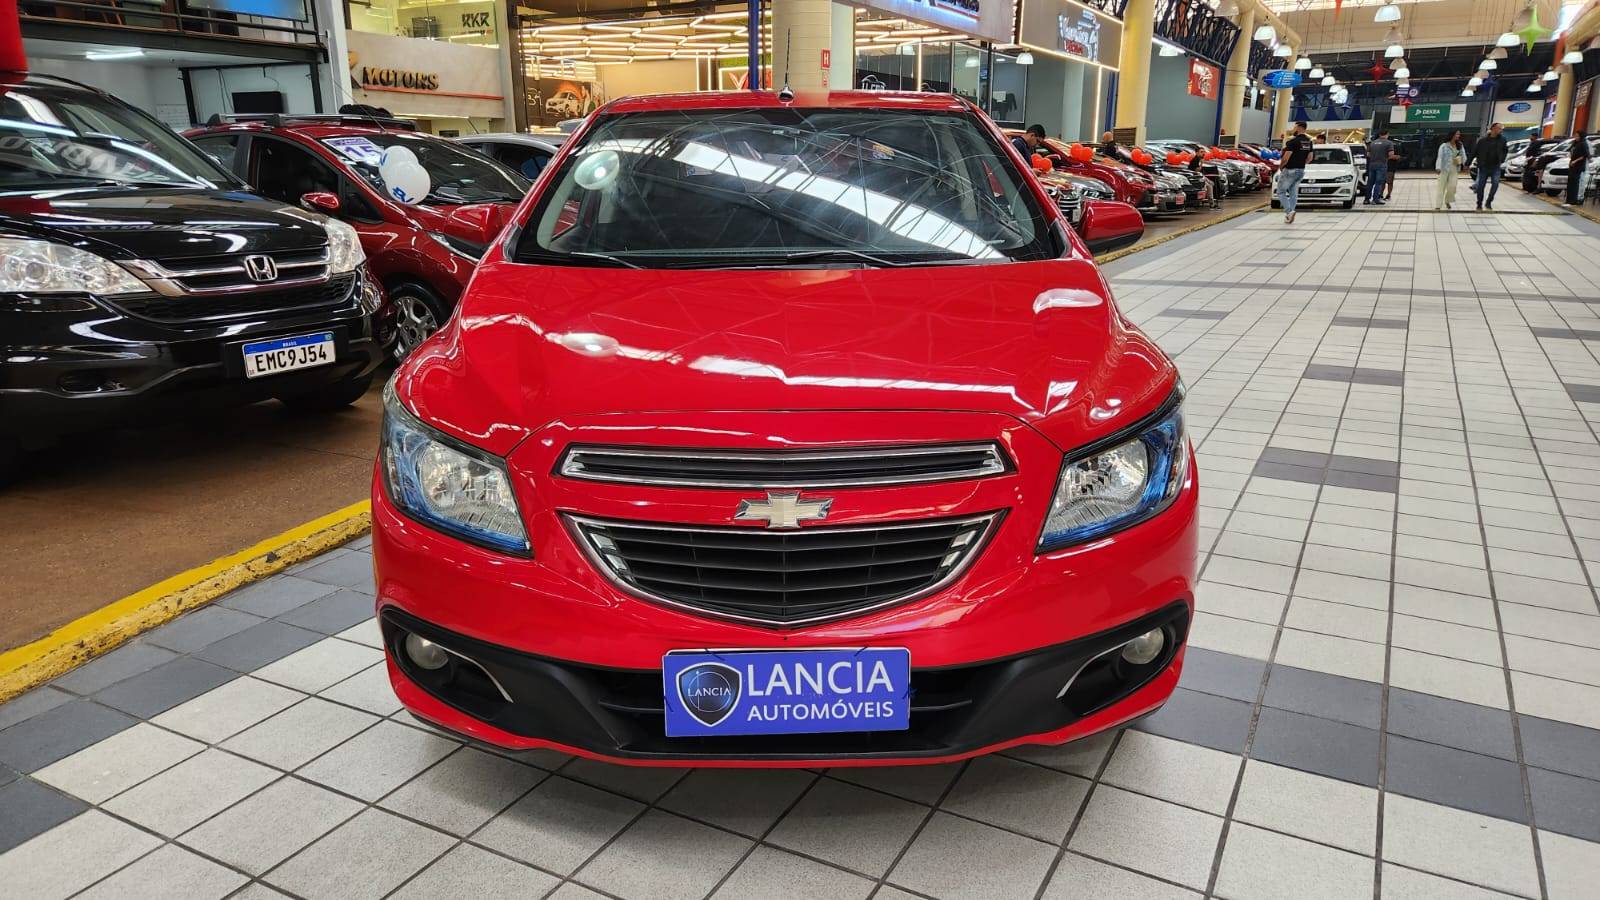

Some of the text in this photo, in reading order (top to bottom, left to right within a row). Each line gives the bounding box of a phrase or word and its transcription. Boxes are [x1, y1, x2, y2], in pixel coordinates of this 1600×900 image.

[462, 12, 490, 28] RKR
[362, 66, 439, 90] MOTORS
[255, 344, 327, 372] EMC9J54
[747, 660, 894, 697] LANCIA
[687, 687, 731, 697] LANCIA
[747, 699, 894, 722] AUTOMÓVEIS
